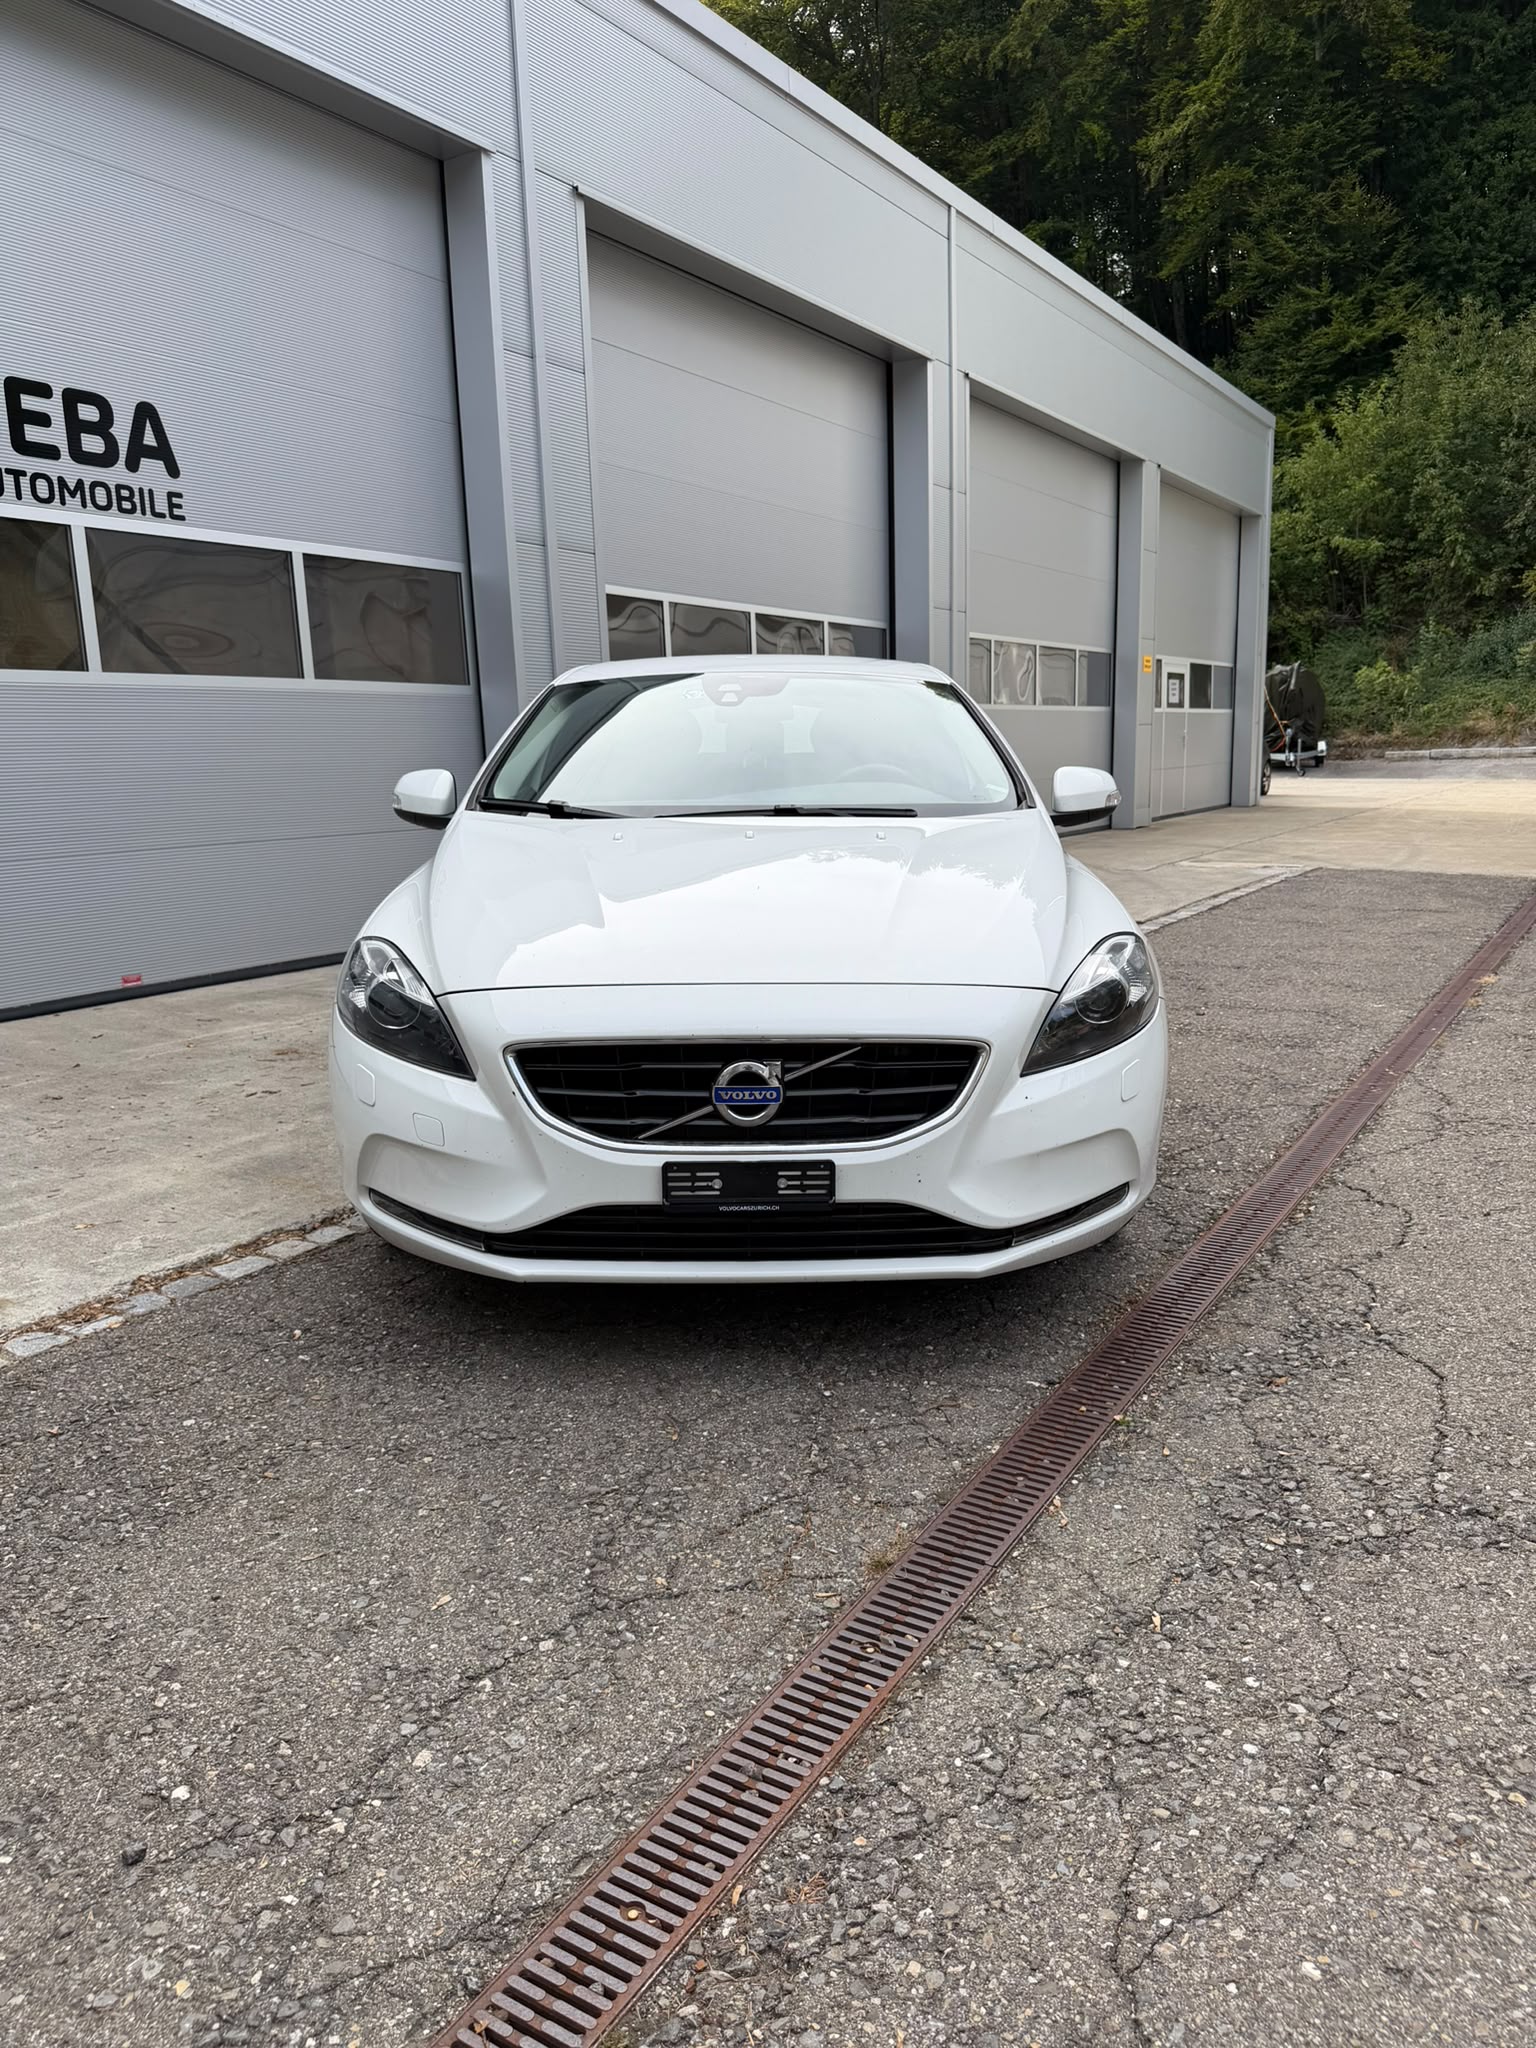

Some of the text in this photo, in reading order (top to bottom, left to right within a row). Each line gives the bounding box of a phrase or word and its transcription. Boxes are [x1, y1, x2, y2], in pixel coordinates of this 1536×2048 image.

[3, 375, 181, 480] EBA
[0, 467, 186, 522] TOMOBILE
[718, 1090, 777, 1100] VOLVO
